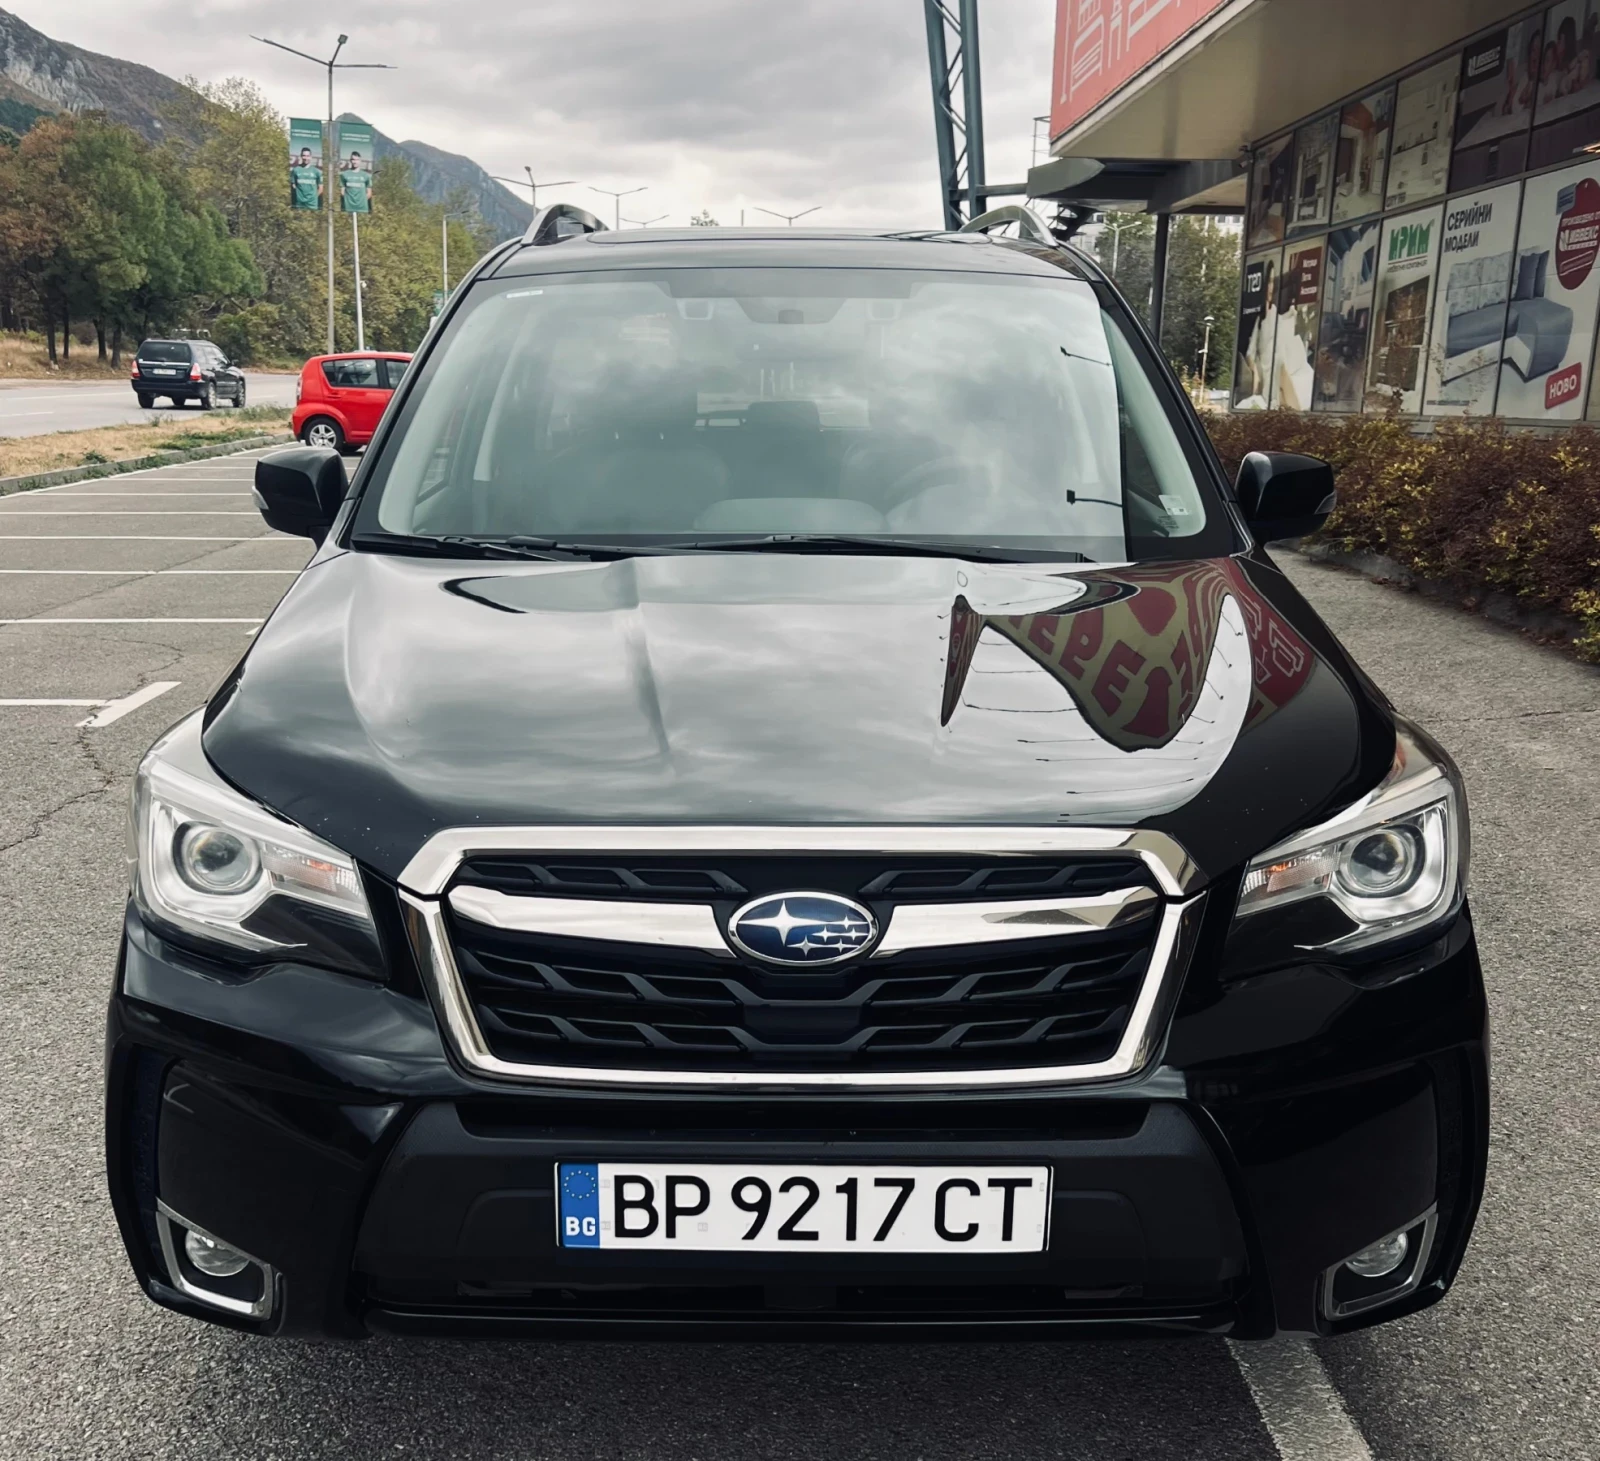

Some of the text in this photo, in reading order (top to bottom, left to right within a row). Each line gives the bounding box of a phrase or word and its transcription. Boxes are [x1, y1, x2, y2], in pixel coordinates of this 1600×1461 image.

[1447, 201, 1493, 232] СЕРИЙНИ
[1444, 231, 1480, 253] МОДЕЛИ
[1549, 374, 1577, 400] НОВО
[613, 1174, 1033, 1242] BP 9217 CT
[565, 1216, 597, 1237] BG
